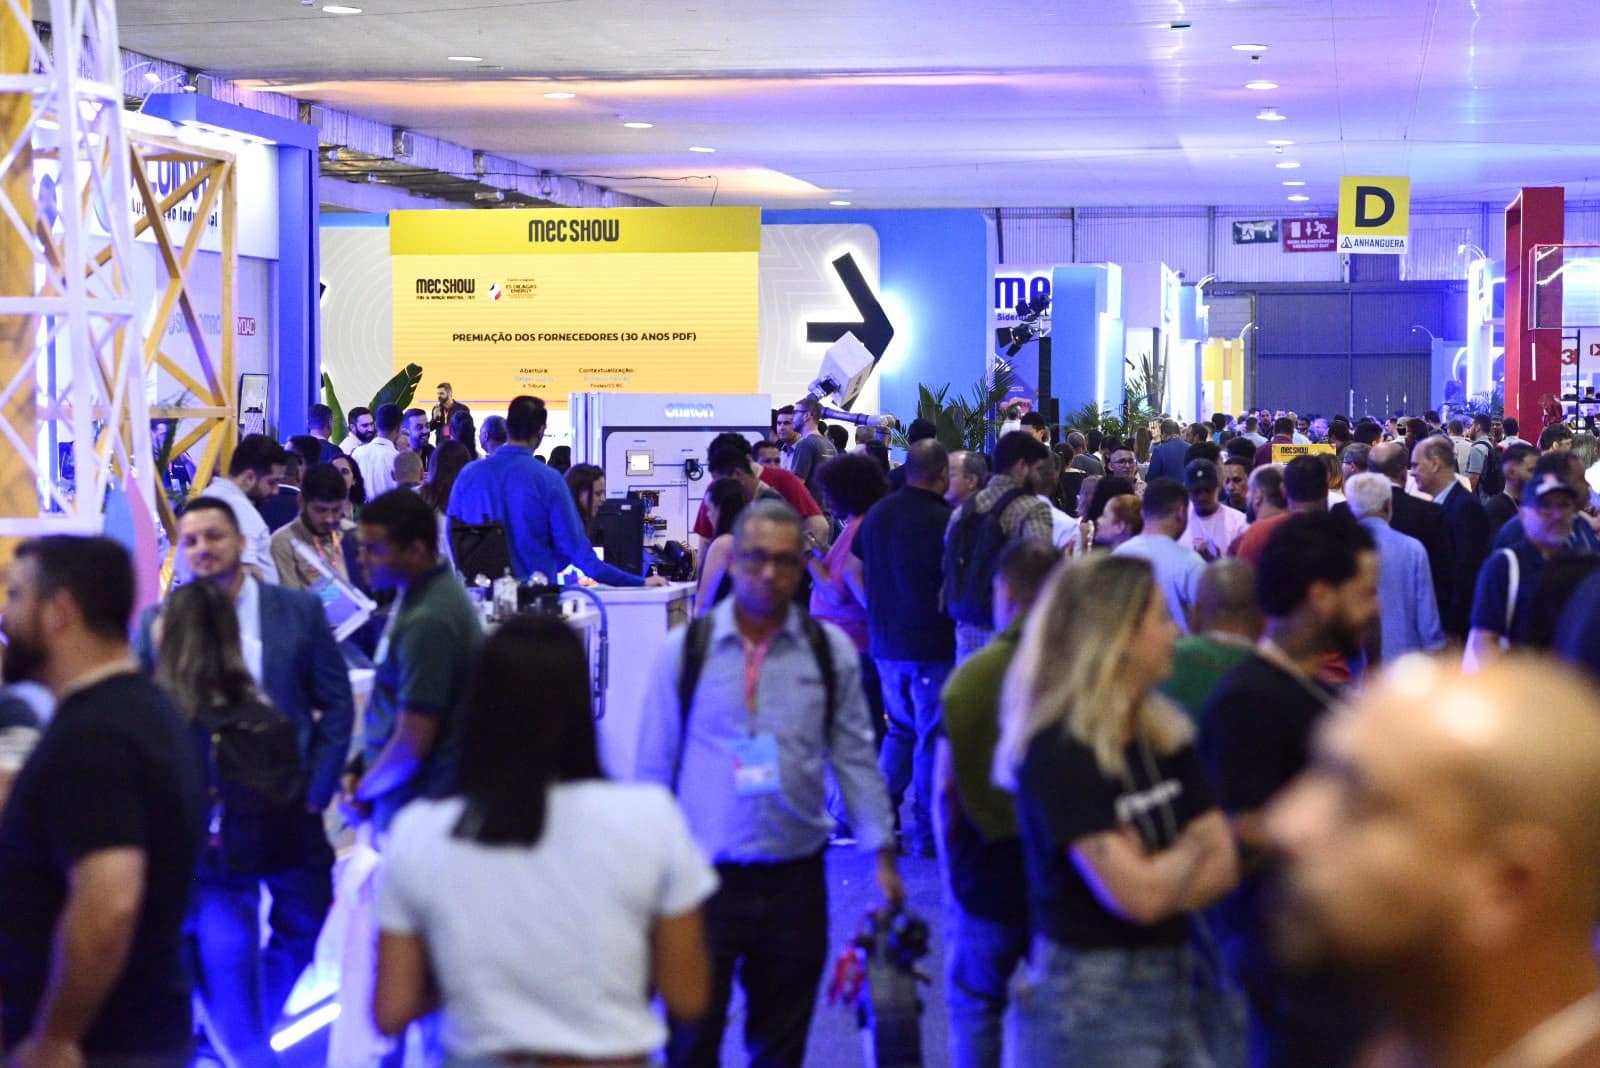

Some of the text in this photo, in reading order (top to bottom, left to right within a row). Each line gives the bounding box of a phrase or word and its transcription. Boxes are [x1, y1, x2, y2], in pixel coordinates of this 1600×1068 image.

[1355, 186, 1395, 227] D
[1353, 237, 1405, 249] ANHANGUERA
[452, 331, 697, 344] PREMIAÇÃO DOS FORNECEDORES (30 ANOS PDF)
[578, 366, 635, 375] Contextualização
